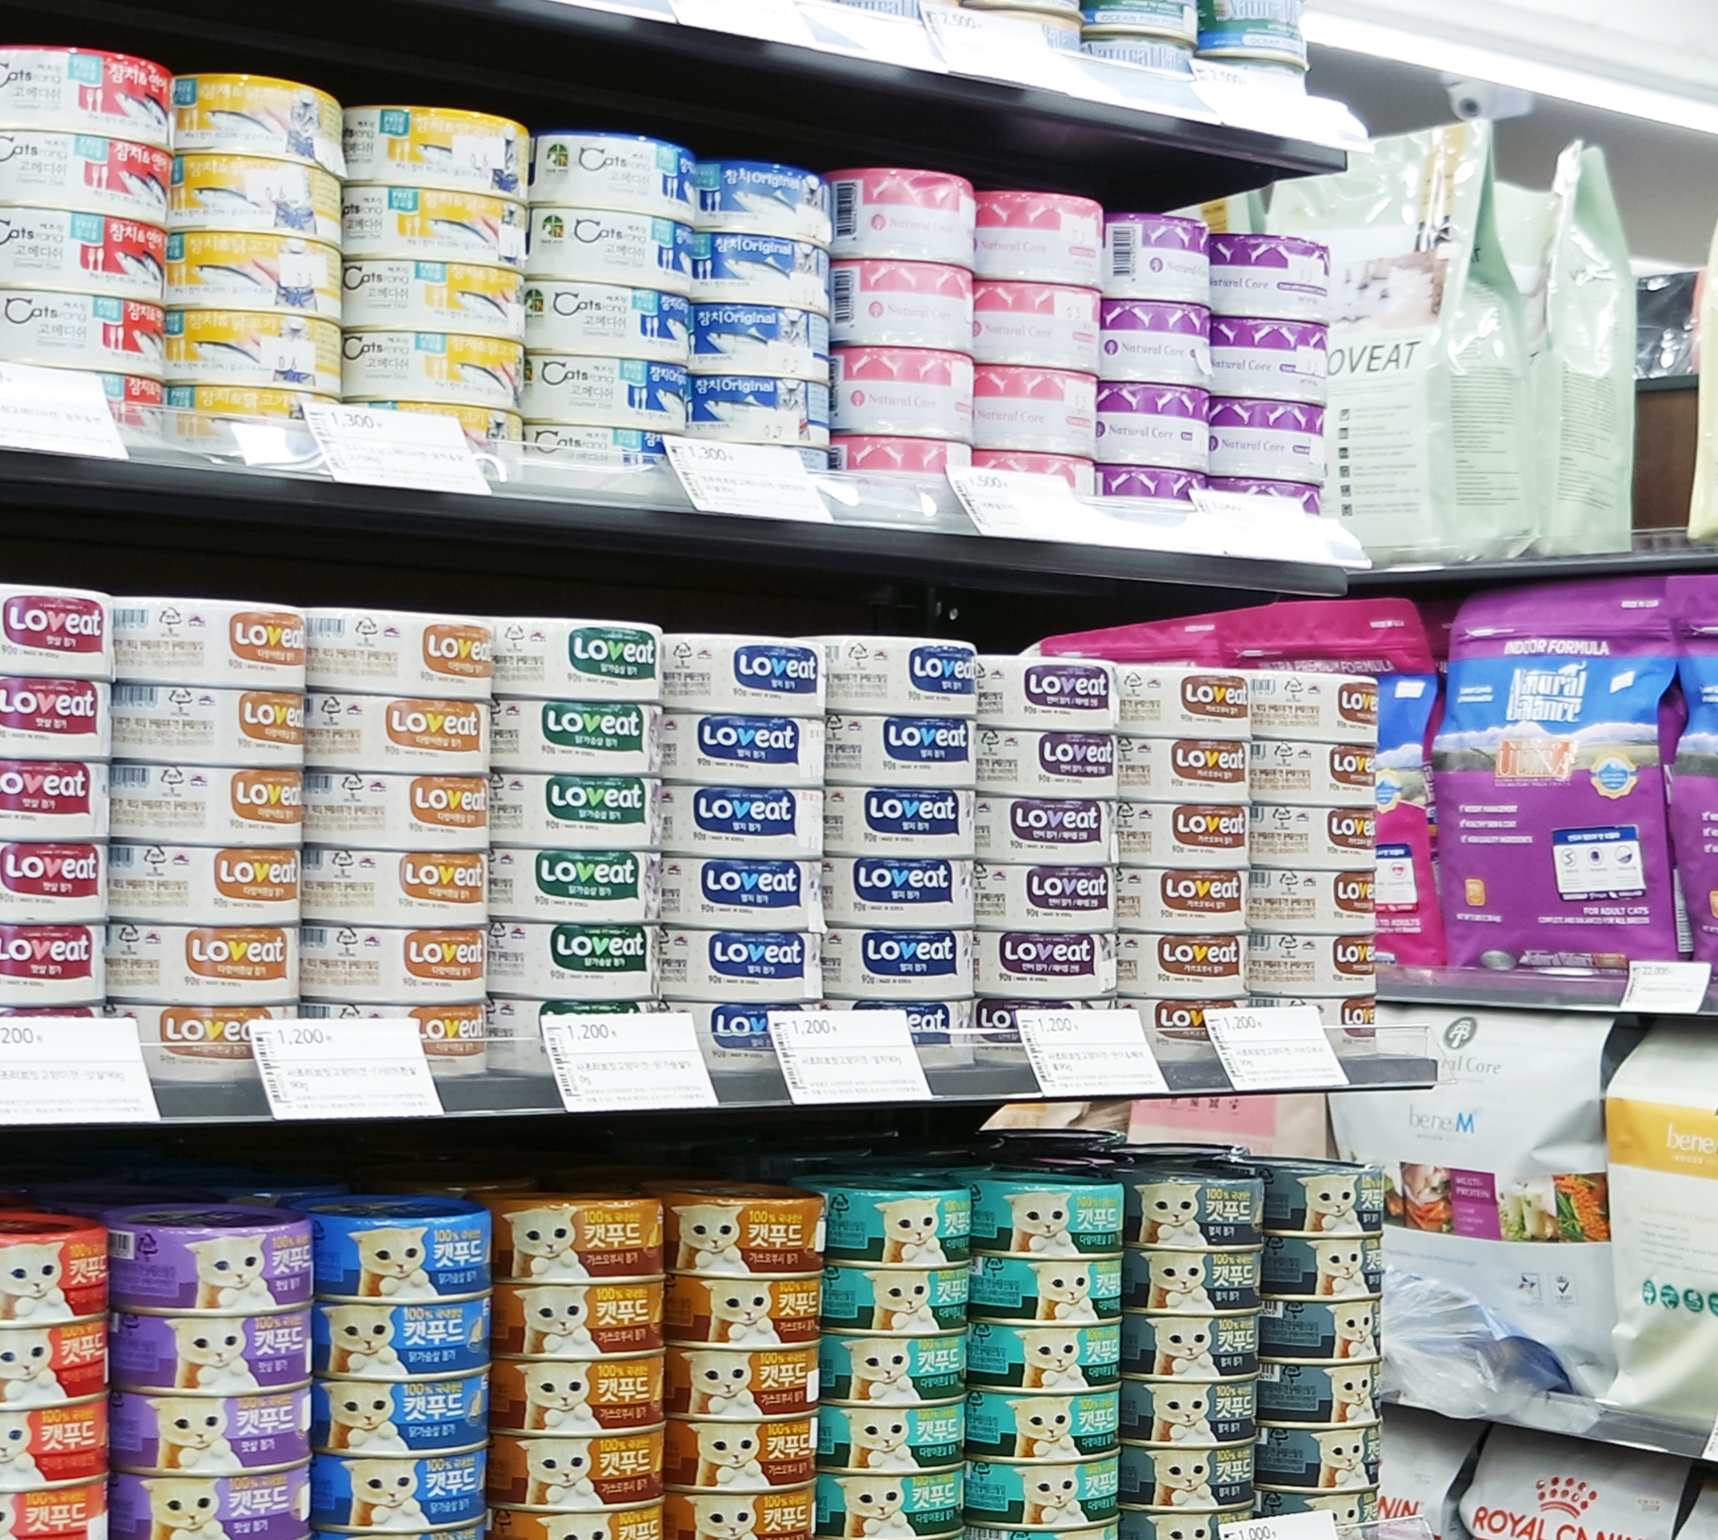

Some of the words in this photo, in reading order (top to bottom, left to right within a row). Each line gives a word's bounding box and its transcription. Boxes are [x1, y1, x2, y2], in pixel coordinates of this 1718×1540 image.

[1121, 342, 1159, 356] Natural
[1162, 344, 1185, 356] Core
[331, 412, 375, 430] 1,300
[1109, 424, 1148, 440] Natural
[1151, 428, 1174, 440] Core
[1221, 438, 1259, 452] Natural
[1261, 440, 1285, 453] Core
[687, 446, 728, 463] 1,300
[1547, 641, 1610, 655] FORMULA
[1511, 669, 1587, 697] Natural
[1627, 907, 1649, 915] CATS
[791, 1018, 830, 1034] 1,200
[1037, 1016, 1073, 1032] 1,200
[1223, 1014, 1256, 1030] 1,200
[277, 1027, 325, 1046] 1,200
[567, 1022, 609, 1040] 1,200
[1456, 1187, 1490, 1199] PROTEIN
[584, 1211, 613, 1223] 100%
[584, 1224, 641, 1248] 캣푸드
[597, 1300, 649, 1325] 캣푸드
[403, 1314, 464, 1346] 캣푸드
[403, 1390, 463, 1422] 캣푸드
[25, 1501, 88, 1532] 캣푸드
